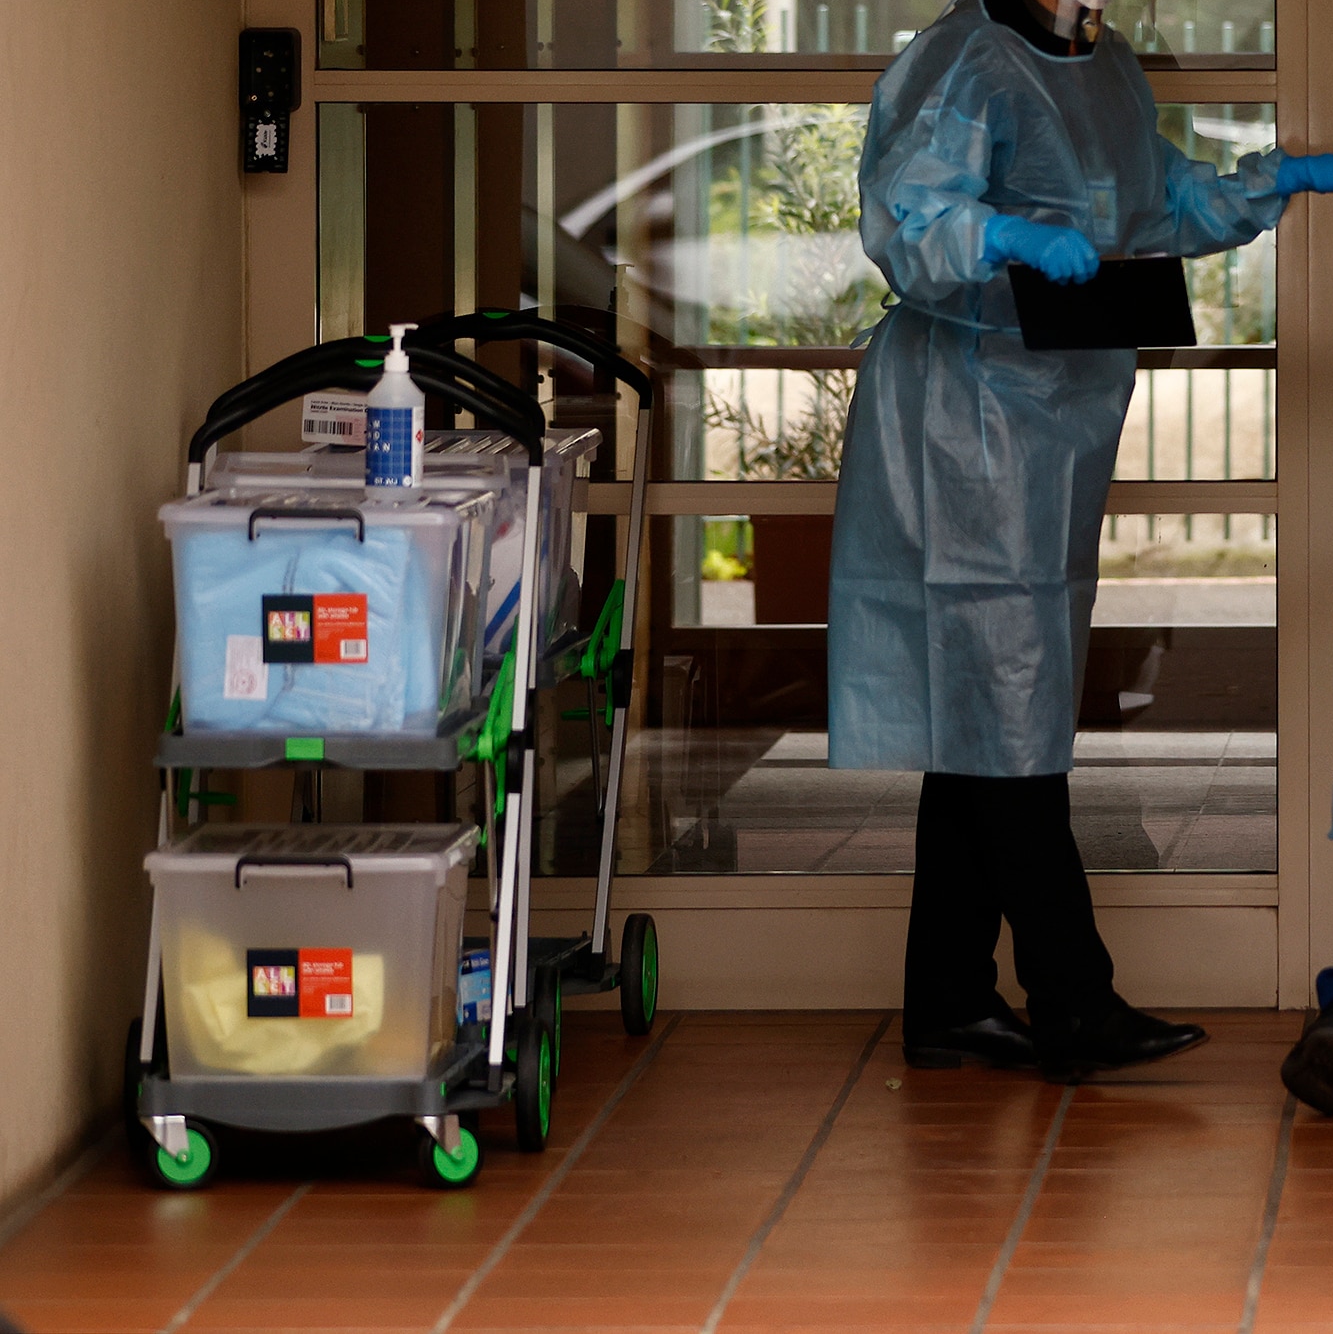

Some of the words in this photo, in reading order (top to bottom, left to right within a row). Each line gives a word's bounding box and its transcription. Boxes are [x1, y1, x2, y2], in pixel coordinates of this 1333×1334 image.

[271, 611, 308, 625] ALL
[272, 626, 309, 641] SET
[256, 966, 292, 979] ALL
